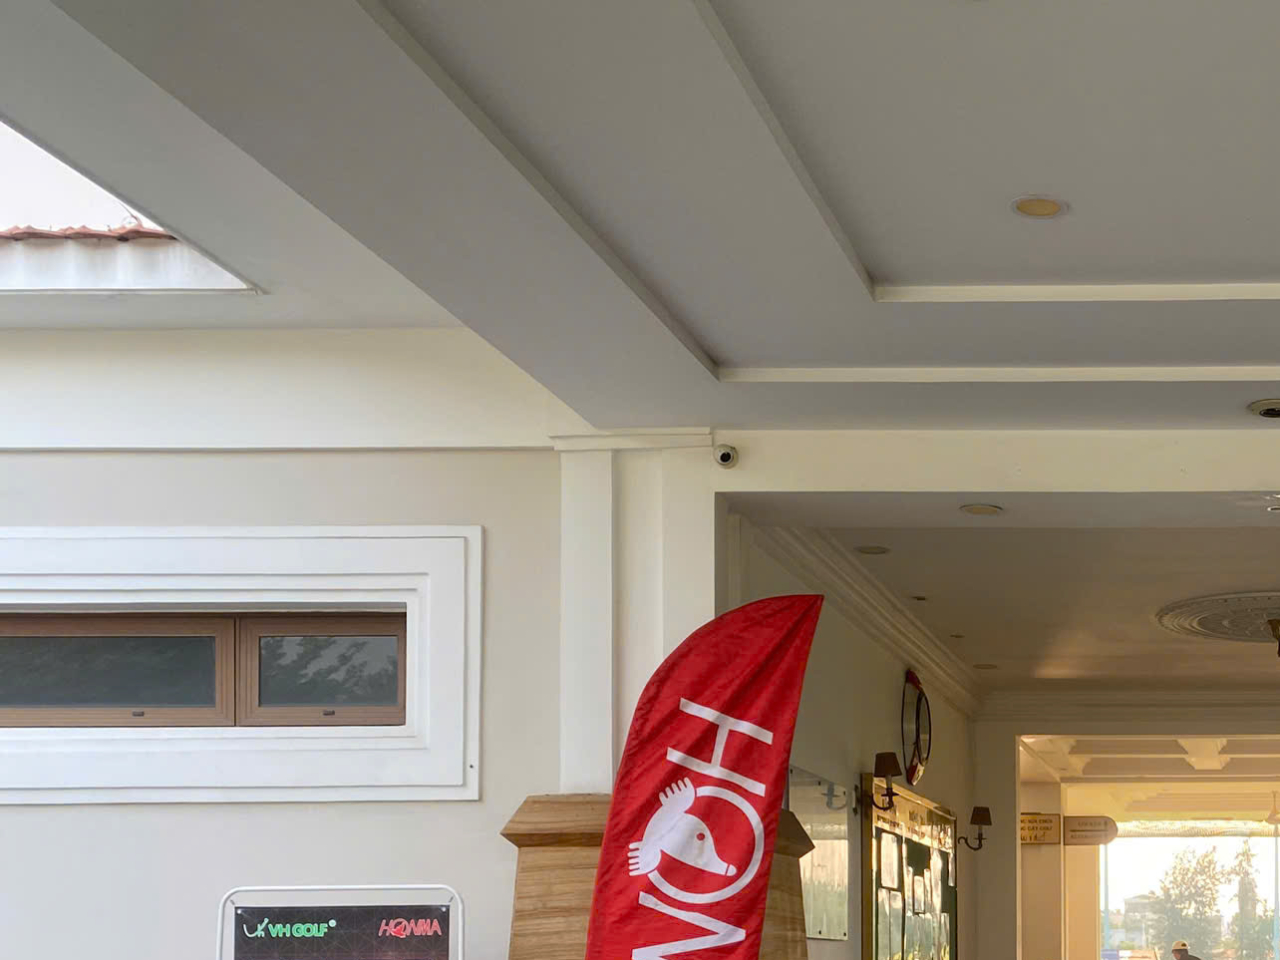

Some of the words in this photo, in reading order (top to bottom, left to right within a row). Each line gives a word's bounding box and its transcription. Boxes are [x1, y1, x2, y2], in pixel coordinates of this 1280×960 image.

[267, 922, 291, 938] VH
[292, 922, 328, 938] GOLF
[378, 917, 442, 939] HONMA
